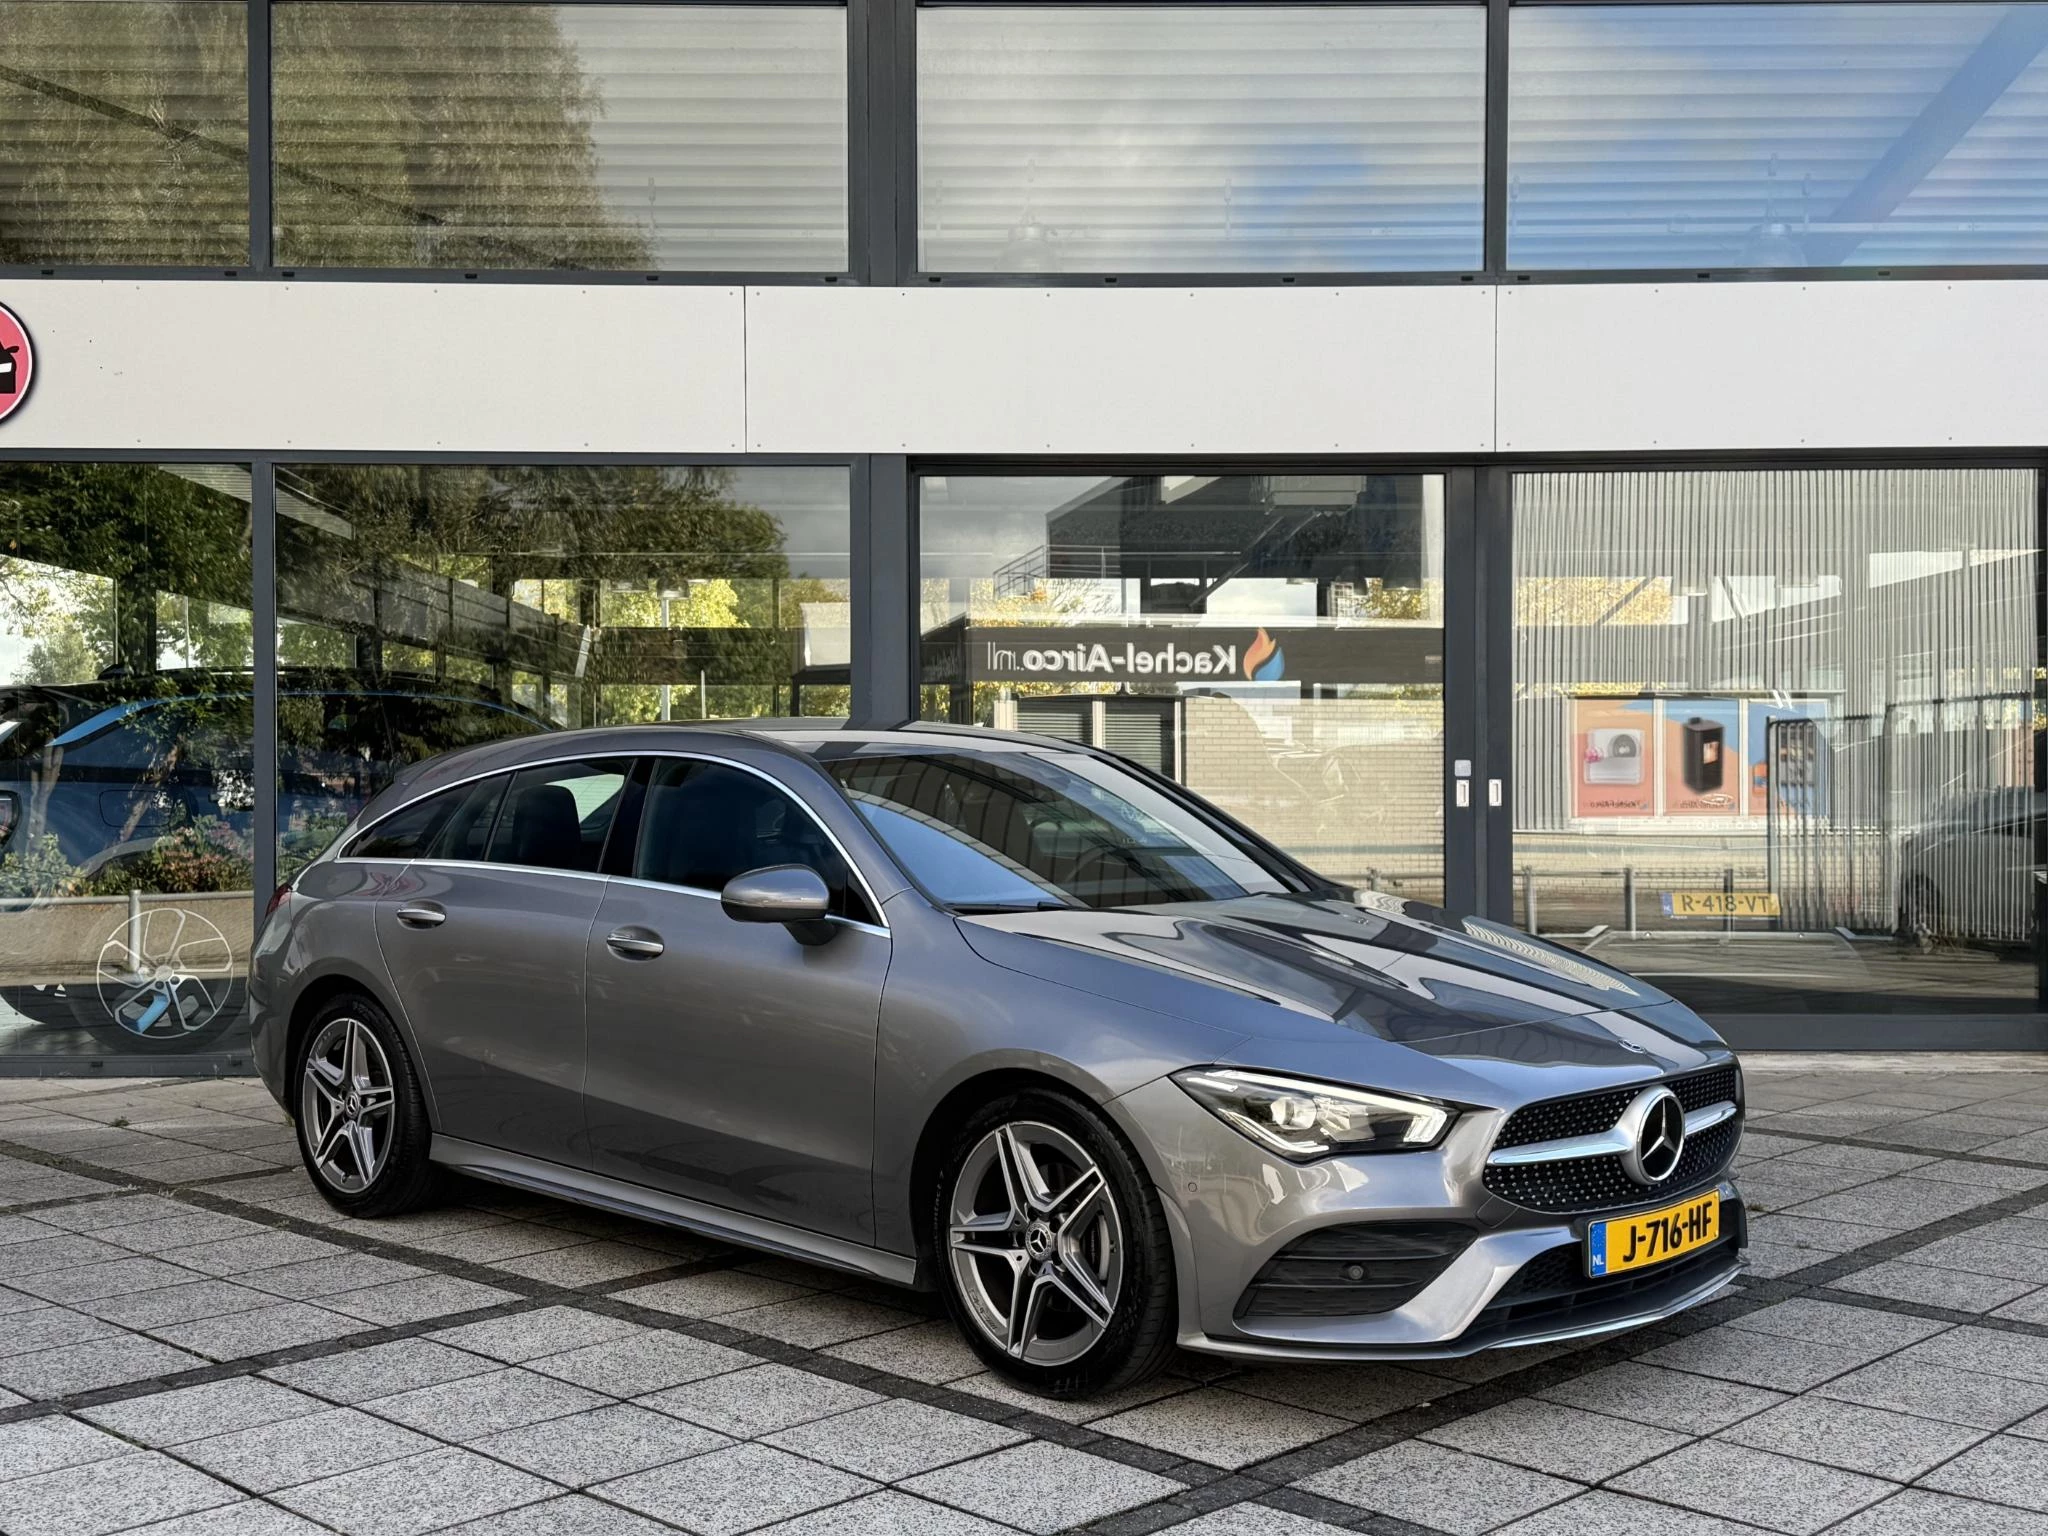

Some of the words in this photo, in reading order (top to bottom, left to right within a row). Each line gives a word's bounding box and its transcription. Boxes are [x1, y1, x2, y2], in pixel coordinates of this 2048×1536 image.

[1681, 894, 1769, 913] R-418-VT
[1622, 1201, 1713, 1263] J-716-HF
[1592, 1254, 1605, 1266] NL
